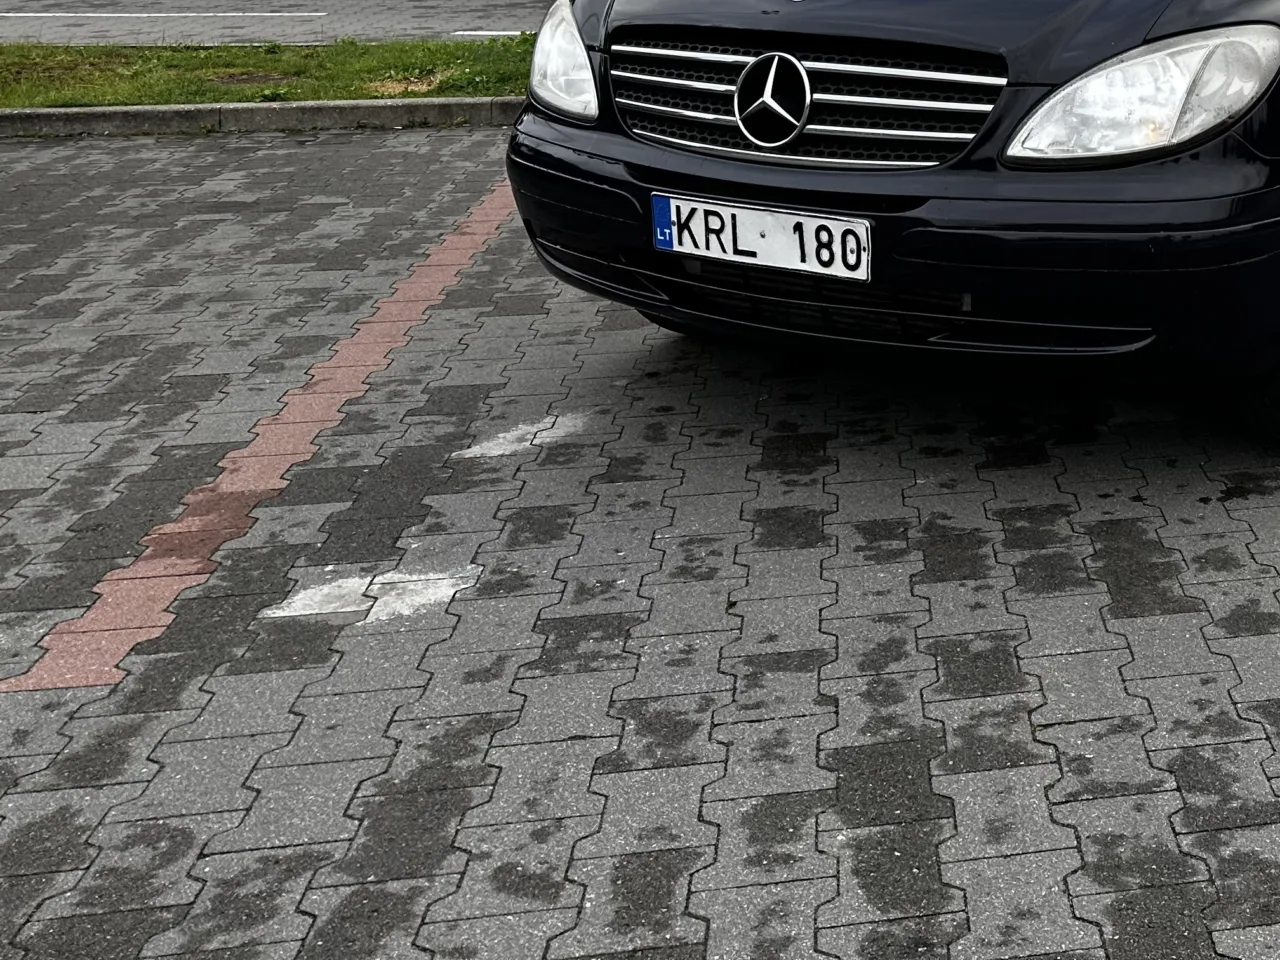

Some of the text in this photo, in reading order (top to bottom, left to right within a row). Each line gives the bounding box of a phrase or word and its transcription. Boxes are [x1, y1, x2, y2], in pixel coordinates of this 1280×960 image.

[657, 227, 671, 241] LT
[675, 204, 862, 272] KRL 180
